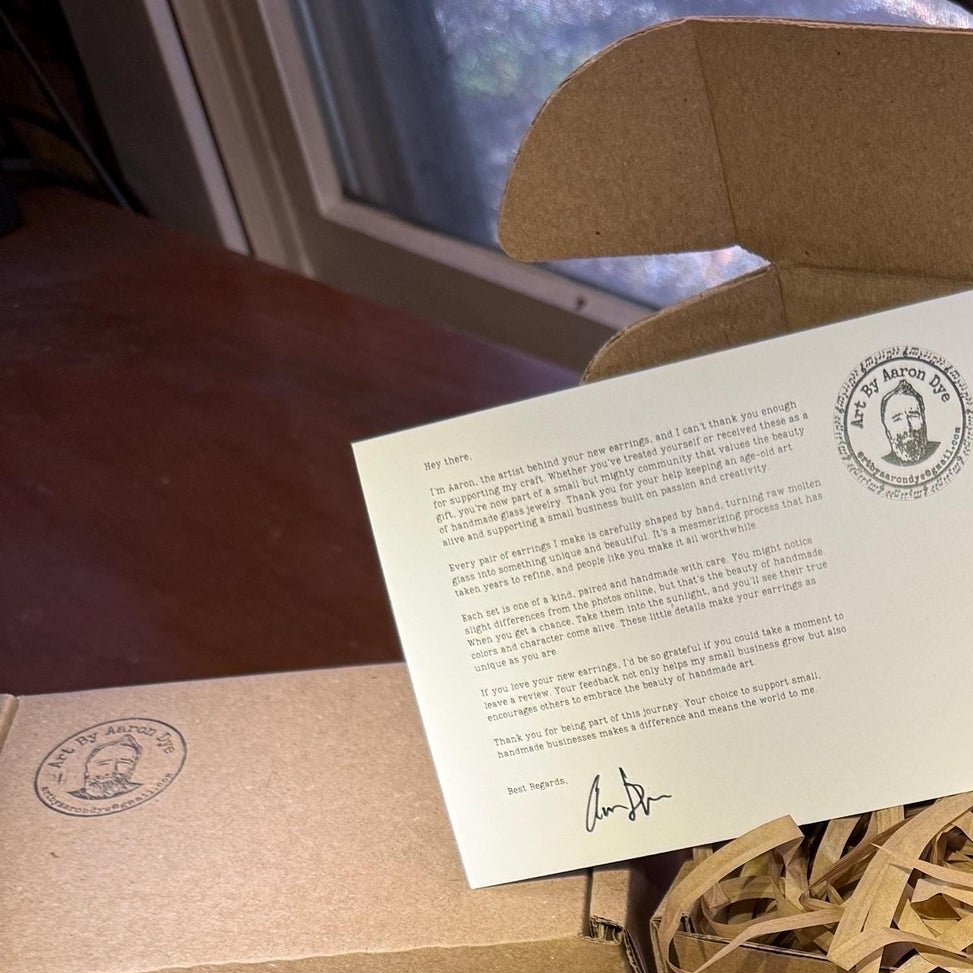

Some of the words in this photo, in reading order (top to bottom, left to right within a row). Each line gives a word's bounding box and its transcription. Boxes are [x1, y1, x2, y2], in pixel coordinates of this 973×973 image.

[851, 399, 867, 429] Art
[860, 378, 879, 398] By
[882, 367, 926, 382] Aaron
[929, 374, 951, 403] Dye
[424, 461, 441, 471] Hey
[450, 486, 500, 504] supporting
[547, 465, 587, 480] Whether
[590, 457, 621, 472] you've
[623, 447, 657, 462] treated
[660, 437, 700, 455] yourself
[716, 424, 757, 440] received
[759, 418, 786, 430] these
[458, 503, 487, 518] you're
[553, 479, 579, 493] small
[601, 468, 634, 481] mighty
[638, 454, 692, 472] community
[718, 440, 750, 453] values
[771, 427, 804, 440] beauty
[498, 466, 524, 479] artist
[526, 457, 559, 472] behind
[682, 422, 706, 434] can't
[708, 414, 738, 428] thank
[761, 401, 797, 415] enough
[442, 536, 465, 546] alive
[487, 518, 538, 536] supporting
[548, 508, 574, 521] small
[575, 499, 618, 514] business
[620, 492, 644, 504] built
[660, 481, 697, 496] passion
[451, 514, 498, 531] handmade
[501, 508, 524, 521] glass
[566, 490, 596, 503] Thank
[685, 460, 723, 475] keeping
[740, 447, 775, 463] age-old
[448, 560, 475, 572] Every
[512, 543, 551, 557] earrings
[599, 521, 641, 536] carefully
[645, 512, 678, 526] shaped
[725, 492, 764, 507] turning
[787, 480, 821, 493] molten
[452, 574, 475, 586] glass
[498, 556, 547, 573] something
[548, 549, 581, 562] unique
[679, 511, 741, 532] mesmerizing
[744, 503, 779, 519] process
[455, 586, 481, 597] taken
[483, 579, 509, 592] years
[576, 557, 605, 570] people
[461, 611, 483, 622] Each
[578, 582, 607, 597] paired
[630, 568, 678, 584] handmade
[752, 544, 781, 557] might
[784, 538, 812, 550] notice
[464, 622, 491, 634] slight
[494, 611, 545, 628] differences
[591, 594, 622, 608] photos
[677, 575, 705, 587] that's
[725, 563, 757, 576] beauty
[773, 548, 822, 565] handmade
[467, 636, 493, 646] When
[732, 575, 759, 590] you'll
[779, 567, 802, 578] their
[471, 648, 498, 659] colors
[520, 634, 563, 649] character
[620, 616, 647, 627] These
[649, 610, 672, 620] little
[675, 602, 706, 614] details
[762, 581, 802, 596] earrings
[663, 643, 701, 659] grateful
[734, 630, 759, 642] could
[793, 615, 832, 629] moment
[474, 660, 506, 672] unique
[484, 699, 507, 709] leave
[579, 674, 620, 689] feedback
[662, 660, 688, 672] helps
[709, 649, 735, 661] small
[737, 641, 779, 655] business
[487, 706, 538, 721] encourages
[540, 699, 570, 710] others
[583, 688, 622, 701] embrace
[641, 677, 673, 689] beauty
[688, 663, 736, 679] handmade
[493, 734, 523, 746] Thank
[560, 721, 586, 732] being
[709, 690, 738, 701] choice
[752, 678, 789, 692] support
[497, 743, 544, 758] handmade
[546, 733, 596, 748] businesses
[599, 726, 629, 738] makes
[639, 714, 686, 729] difference
[708, 703, 739, 715] means
[759, 691, 786, 703] world
[47, 747, 75, 769] Art
[74, 732, 98, 746] By
[105, 724, 157, 736] Aaron
[507, 785, 527, 795] Best
